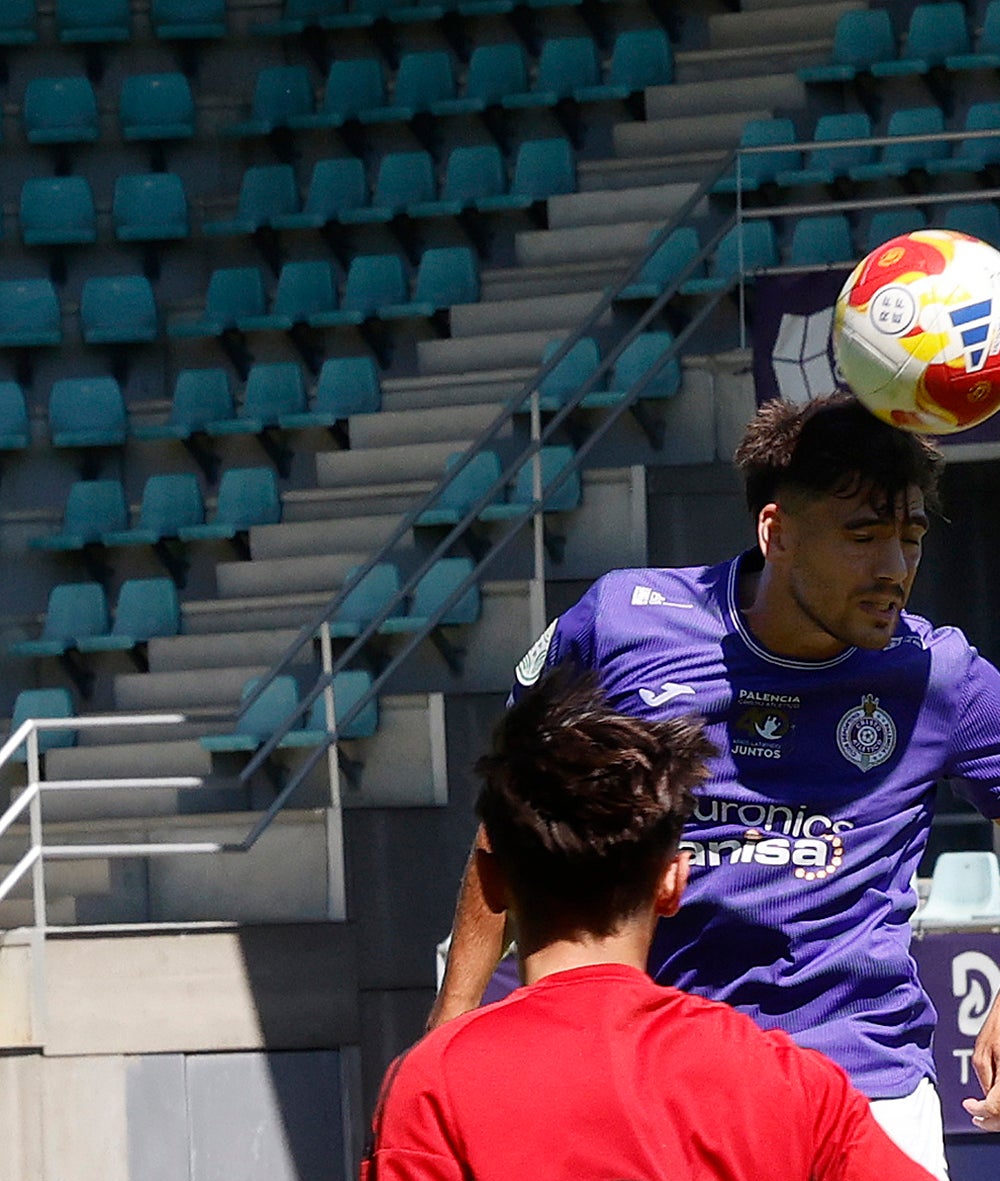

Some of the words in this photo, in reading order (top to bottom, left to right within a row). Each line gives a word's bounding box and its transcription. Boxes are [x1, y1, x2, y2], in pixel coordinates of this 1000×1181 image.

[739, 689, 801, 703] PALENCIA
[730, 745, 782, 759] JUNTOS
[691, 799, 855, 840] uronics
[678, 828, 829, 867] anisa
